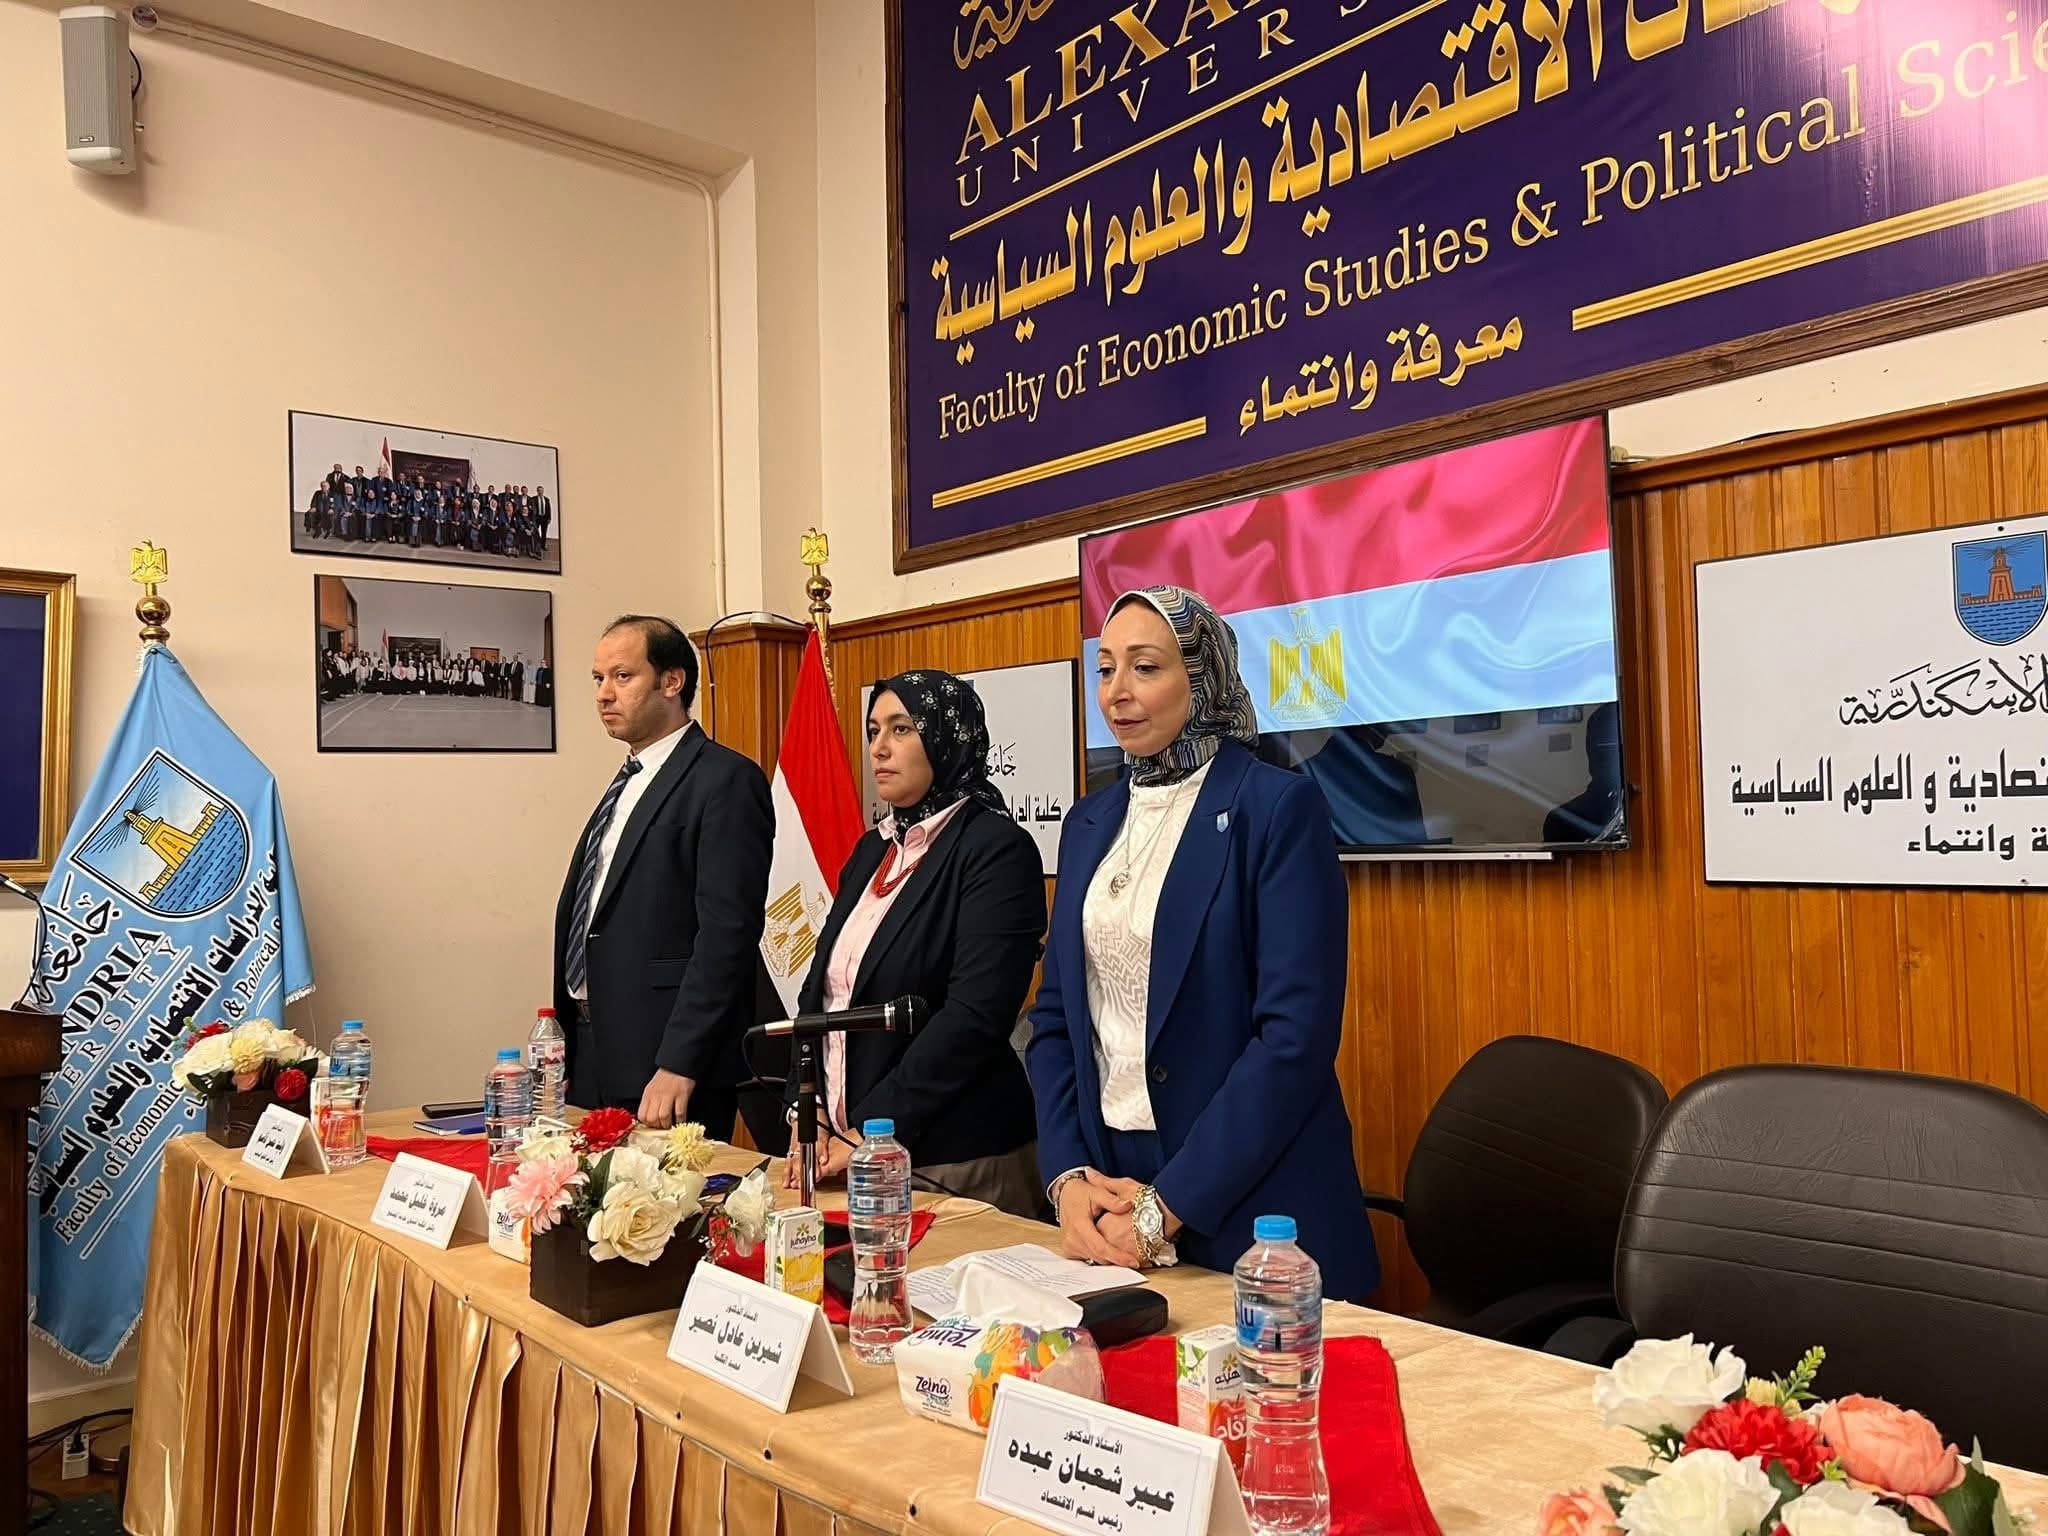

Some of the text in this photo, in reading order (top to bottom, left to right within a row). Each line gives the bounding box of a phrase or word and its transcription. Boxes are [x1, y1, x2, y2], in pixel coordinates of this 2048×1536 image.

[955, 0, 1262, 165] ALEXA
[938, 370, 1045, 440] Faculty
[1055, 345, 1087, 396] of
[1097, 288, 1287, 384] Economic
[1305, 216, 1489, 317] Studies
[1511, 182, 1559, 248] &
[1581, 65, 1867, 227] Political
[1104, 138, 1255, 306] والعلوم
[931, 200, 1093, 365] السياسية
[1238, 316, 1524, 437] معرفة وانتماء
[986, 742, 1017, 777] جامع
[1731, 756, 1832, 816] السياسية
[1843, 753, 1912, 815] العلوم
[1035, 794, 1062, 830] كلية
[1923, 769, 1937, 813] و
[1907, 824, 2016, 860] وانتماء
[56, 933, 281, 1241] Faculty of Economic & Political
[84, 1061, 152, 1141] والعلوم
[689, 1313, 782, 1364] شيرين عادل نصير
[915, 1375, 949, 1398] Zeina
[1063, 1429, 1094, 1446] الدكتور
[1008, 1438, 1176, 1513] عبير شعبان عبده
[1040, 1489, 1123, 1533] رئيس قسم الاقتصاد
